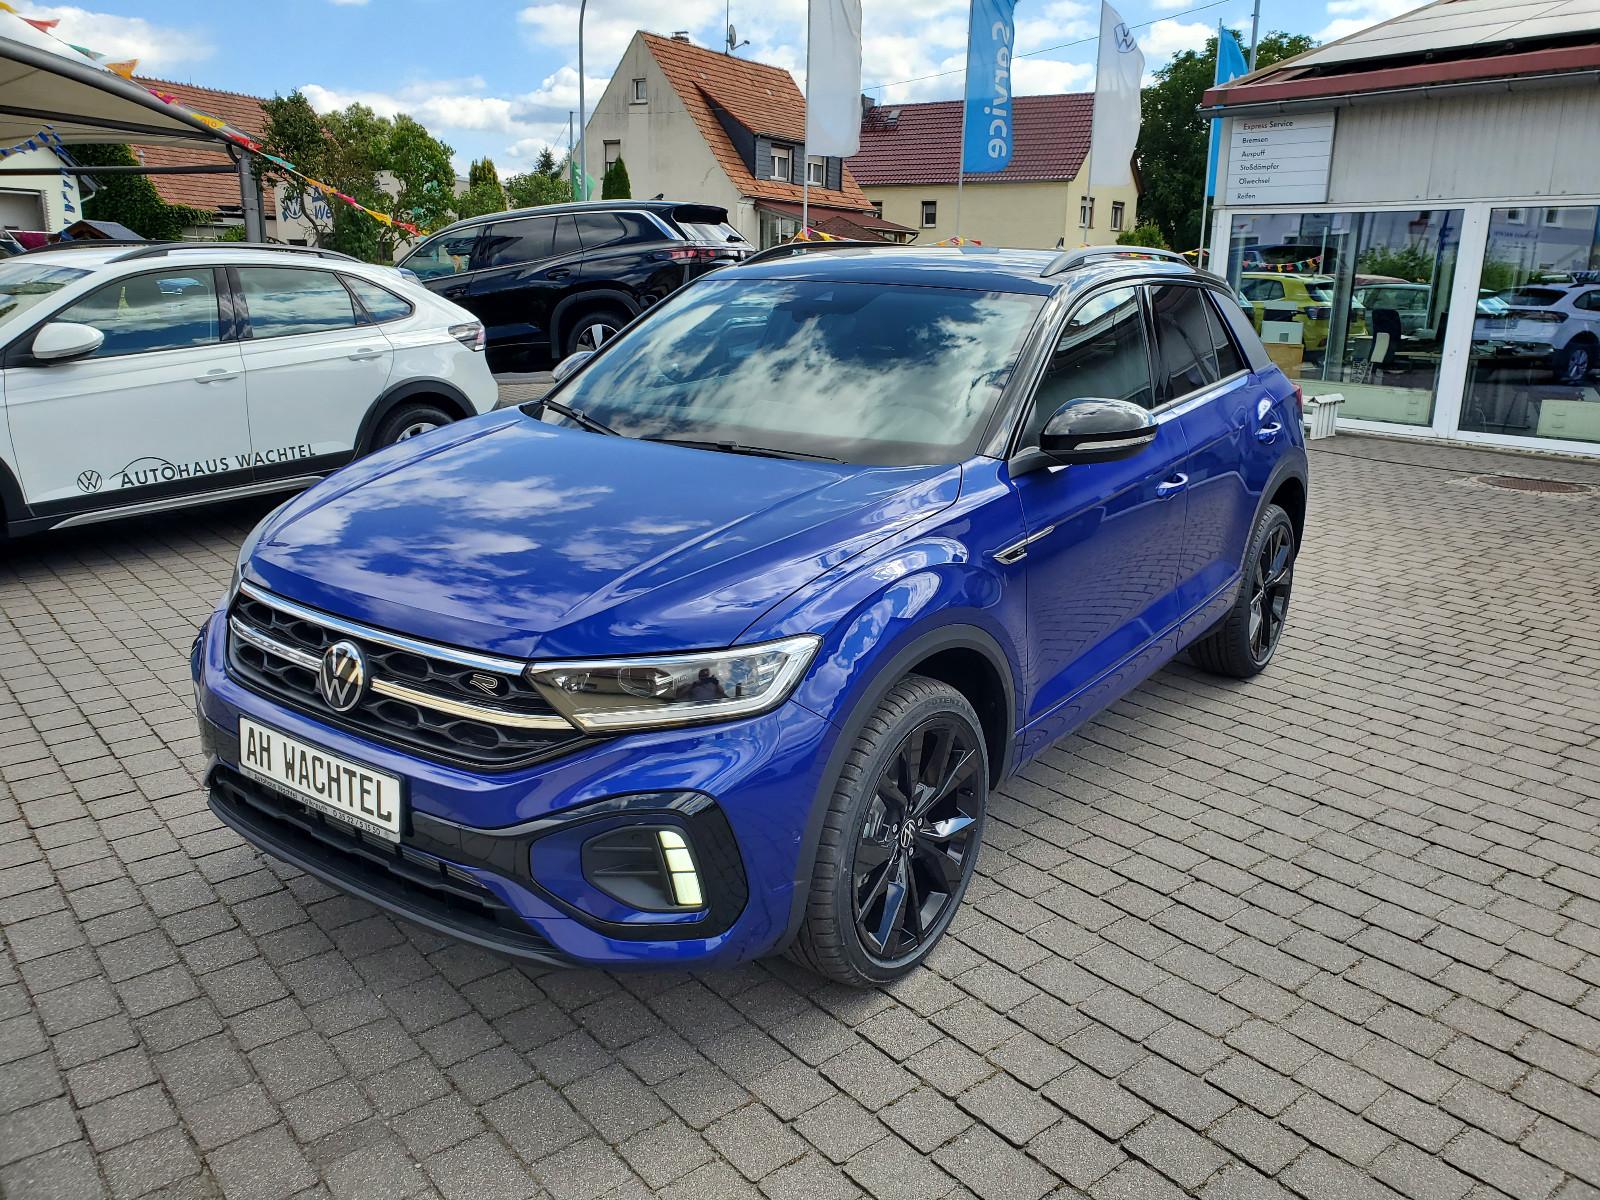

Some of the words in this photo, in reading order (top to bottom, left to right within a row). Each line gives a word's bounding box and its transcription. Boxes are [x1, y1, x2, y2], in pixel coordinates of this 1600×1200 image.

[1269, 120, 1293, 128] Service
[121, 457, 229, 488] AUTOHAUS
[235, 443, 316, 468] WACHTEL
[246, 726, 272, 771] AH
[283, 742, 392, 823] WACHTEL
